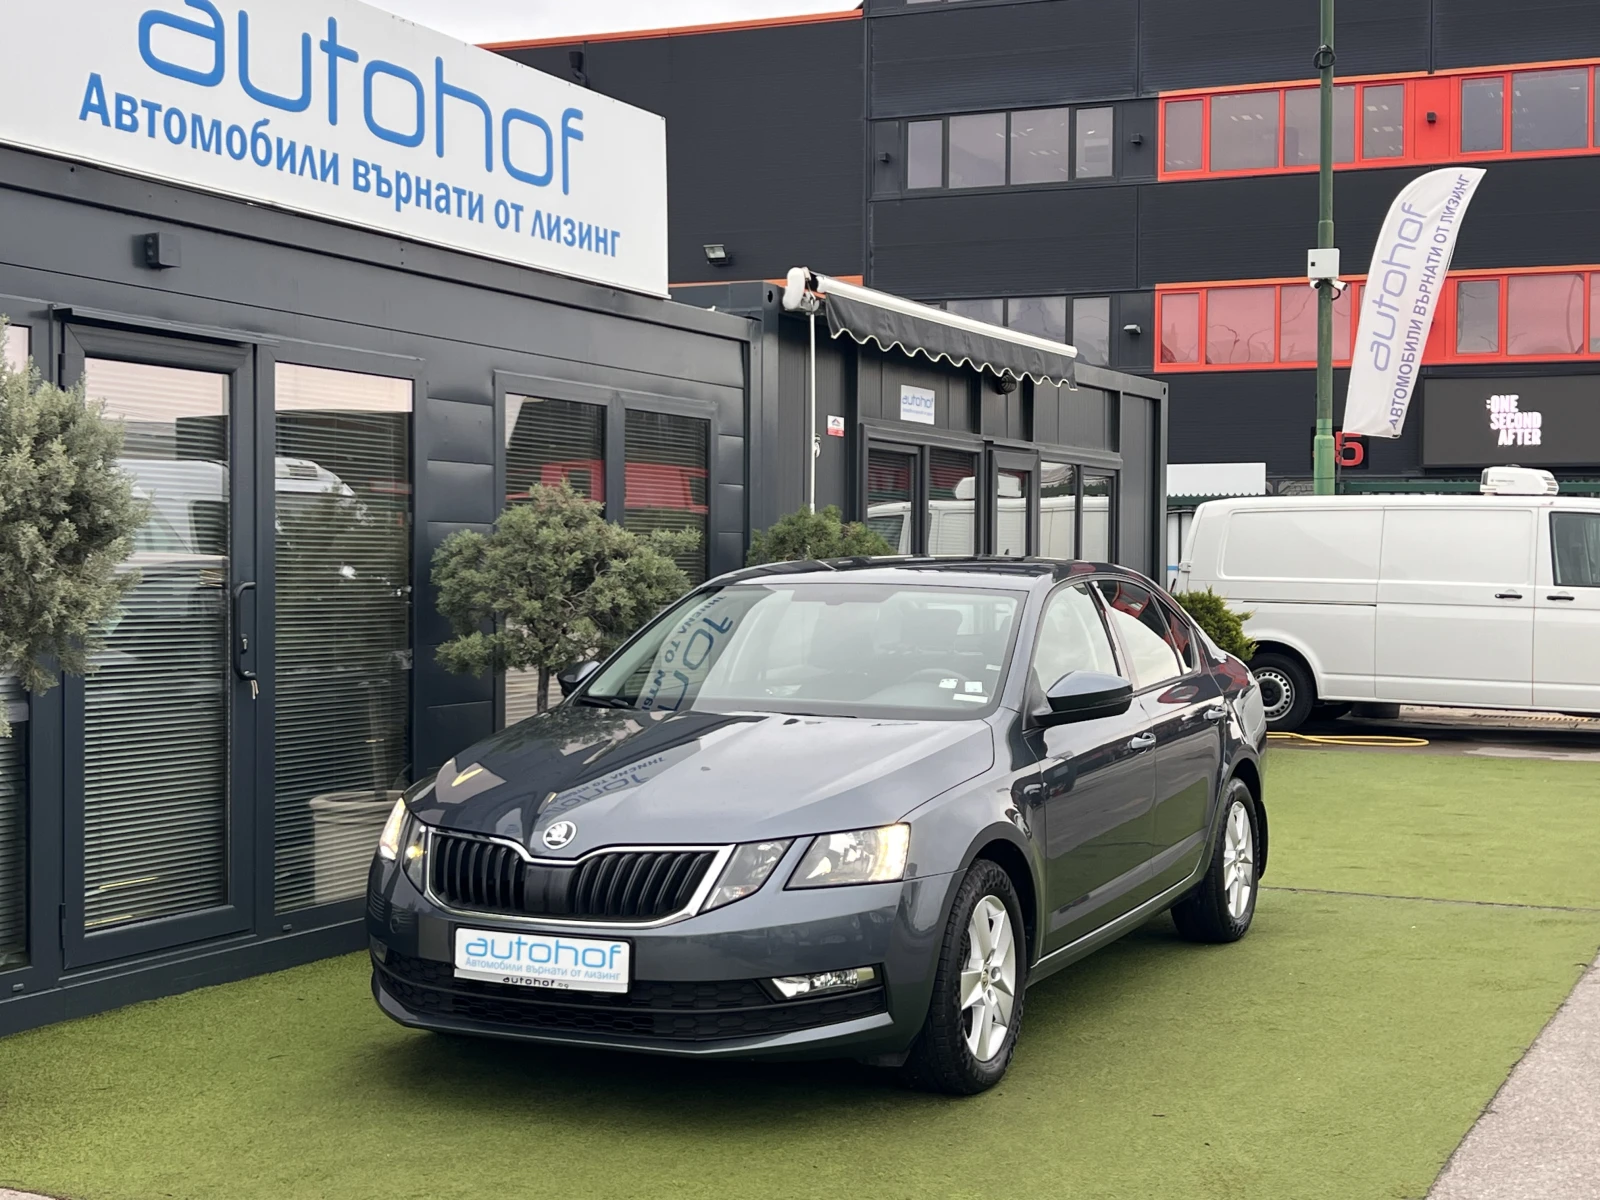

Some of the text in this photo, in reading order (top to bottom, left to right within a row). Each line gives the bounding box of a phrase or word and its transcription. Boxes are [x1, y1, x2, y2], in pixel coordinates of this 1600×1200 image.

[138, 0, 584, 195] autohof
[79, 73, 621, 257] Автомобили върнати от лизинг
[1370, 202, 1427, 371] autohof
[1389, 174, 1470, 430] АВТОМОБИЛИ ВЪРНАТИ ОТ ЛИЗИНГ
[1490, 411, 1542, 430] SECOND
[1498, 428, 1542, 446] AFTER
[465, 936, 621, 969] autohof
[465, 956, 621, 981] Автомобили върнати от лизинг
